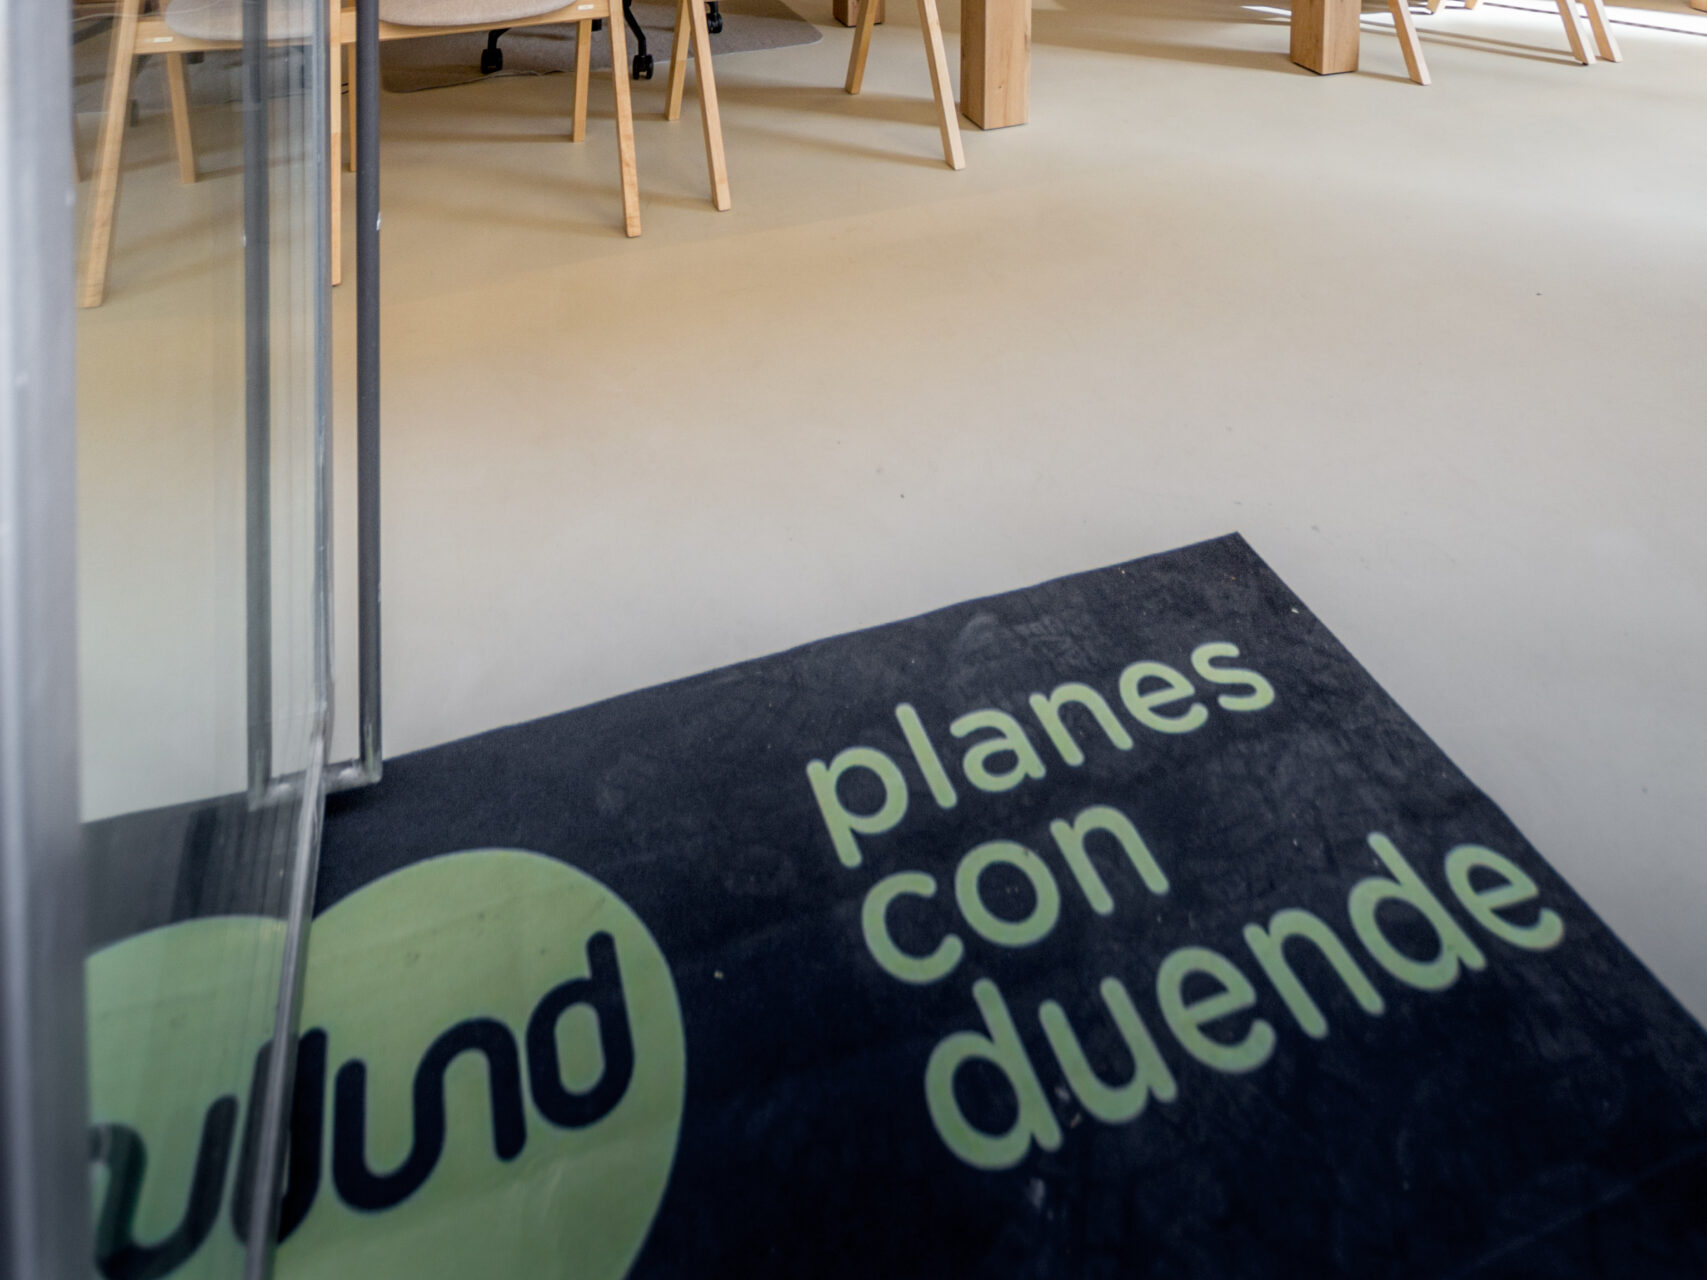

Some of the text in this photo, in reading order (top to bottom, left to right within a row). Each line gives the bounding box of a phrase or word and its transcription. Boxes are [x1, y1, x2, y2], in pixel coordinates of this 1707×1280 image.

[807, 641, 1276, 869] planes
[861, 805, 1169, 985] con
[925, 832, 1564, 1170] duende
